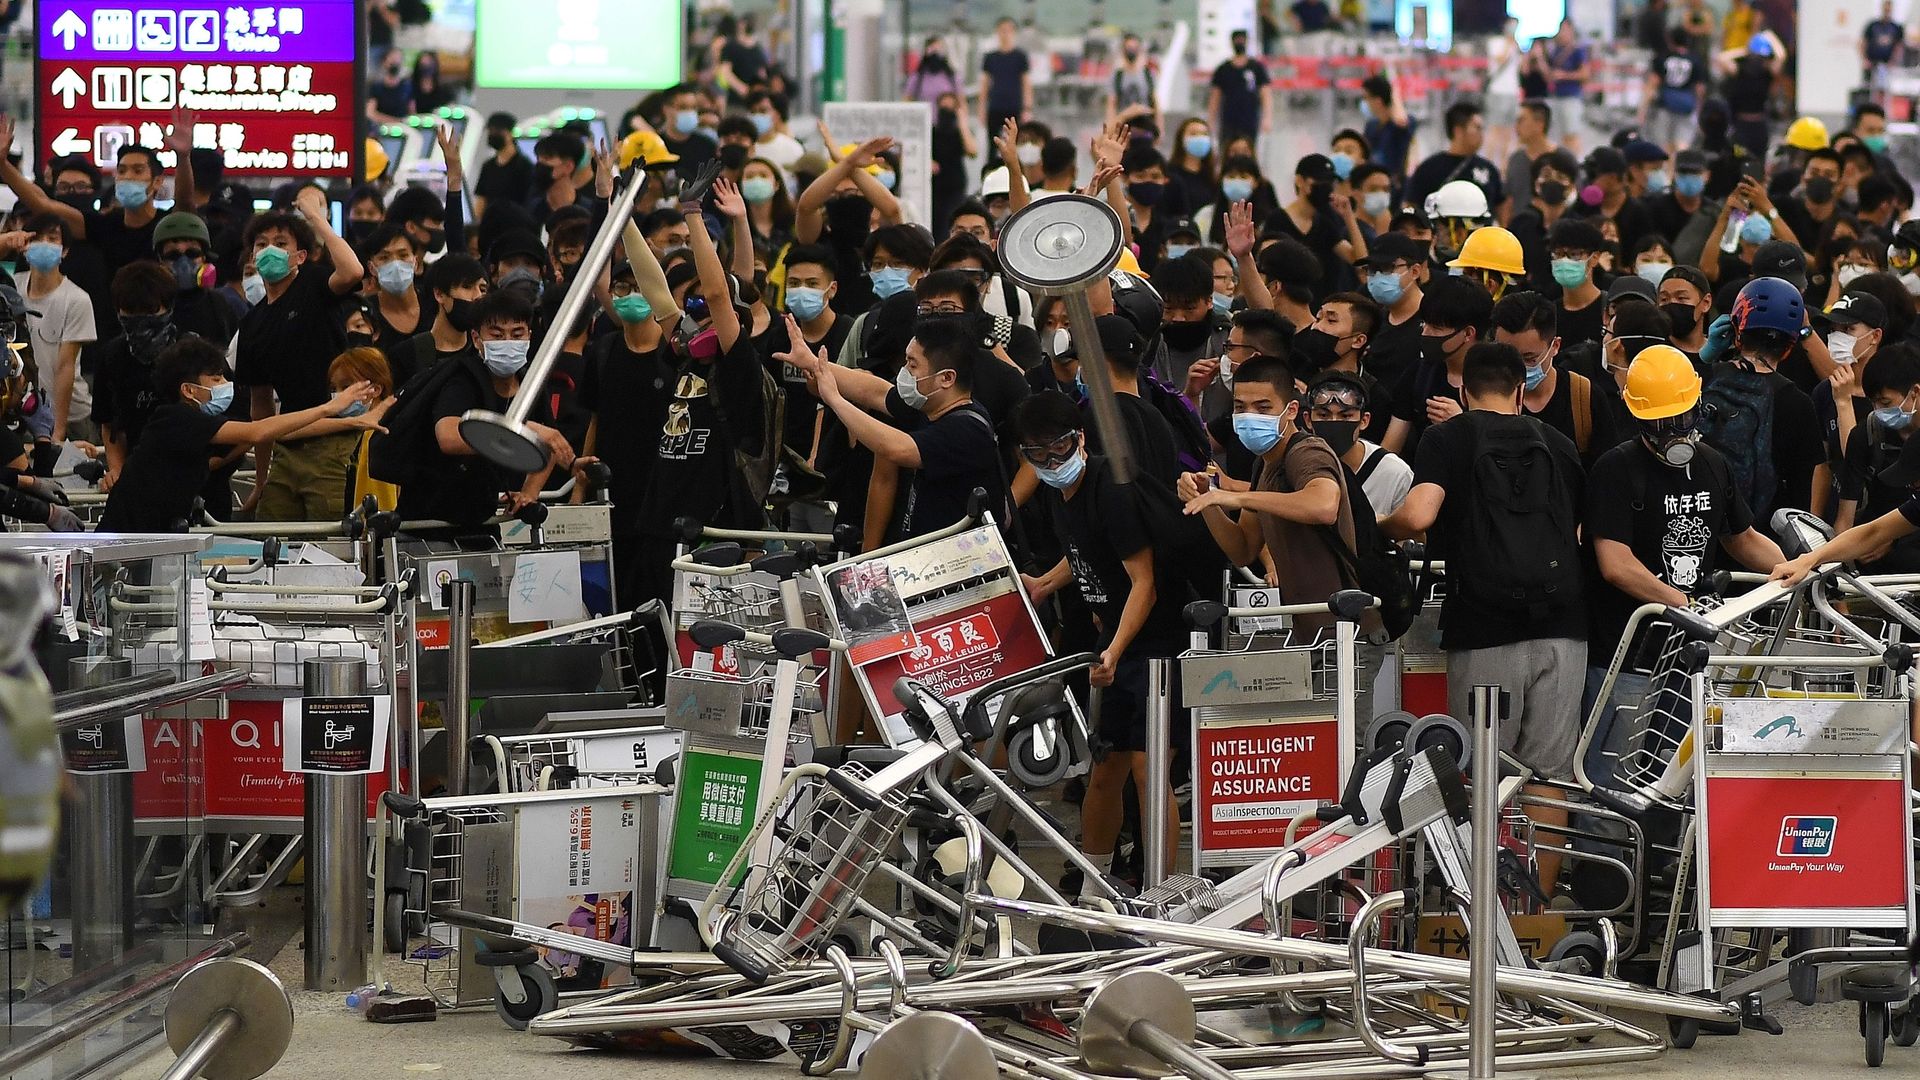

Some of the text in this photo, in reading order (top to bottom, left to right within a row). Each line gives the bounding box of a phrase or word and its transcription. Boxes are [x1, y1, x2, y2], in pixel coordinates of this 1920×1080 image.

[225, 7, 304, 34] 洗手間
[226, 33, 281, 52] Toilets
[224, 150, 288, 169] Service
[1664, 491, 1711, 514] 依存症
[913, 643, 989, 671] MA PAK LEUNG
[933, 668, 995, 694] SINCE1822
[1211, 736, 1316, 757] INTELLIGENT
[1211, 757, 1281, 776] QUALITY
[240, 774, 285, 789] (Formerly
[1211, 776, 1311, 796] ASSURANCE
[702, 781, 746, 805] 用微信支付
[700, 801, 743, 826] 享雙重優惠
[1785, 827, 1831, 839] UnionPay
[1768, 862, 1844, 874] UnionPay Your Way
